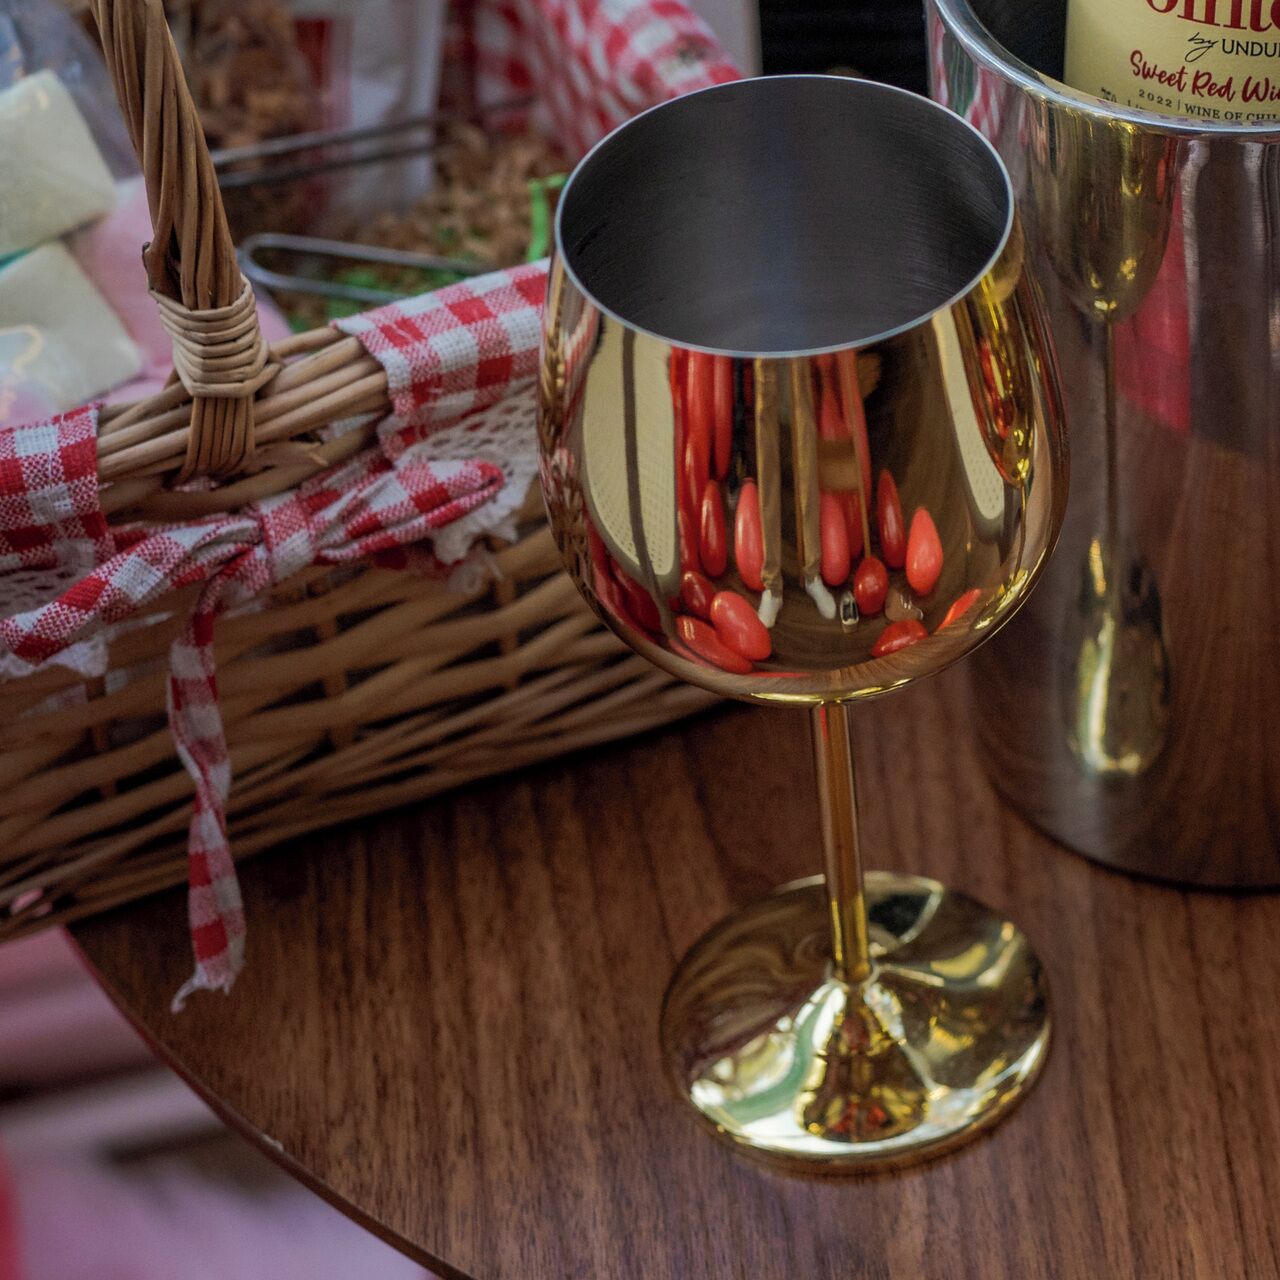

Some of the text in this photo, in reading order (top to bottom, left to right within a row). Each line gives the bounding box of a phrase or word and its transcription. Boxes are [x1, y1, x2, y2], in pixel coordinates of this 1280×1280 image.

[1184, 31, 1219, 63] by
[1129, 49, 1189, 92] Sweet
[1191, 70, 1236, 102] Red
[1138, 88, 1173, 108] 2022
[1185, 103, 1221, 120] WINE
[1223, 110, 1243, 121] OF
